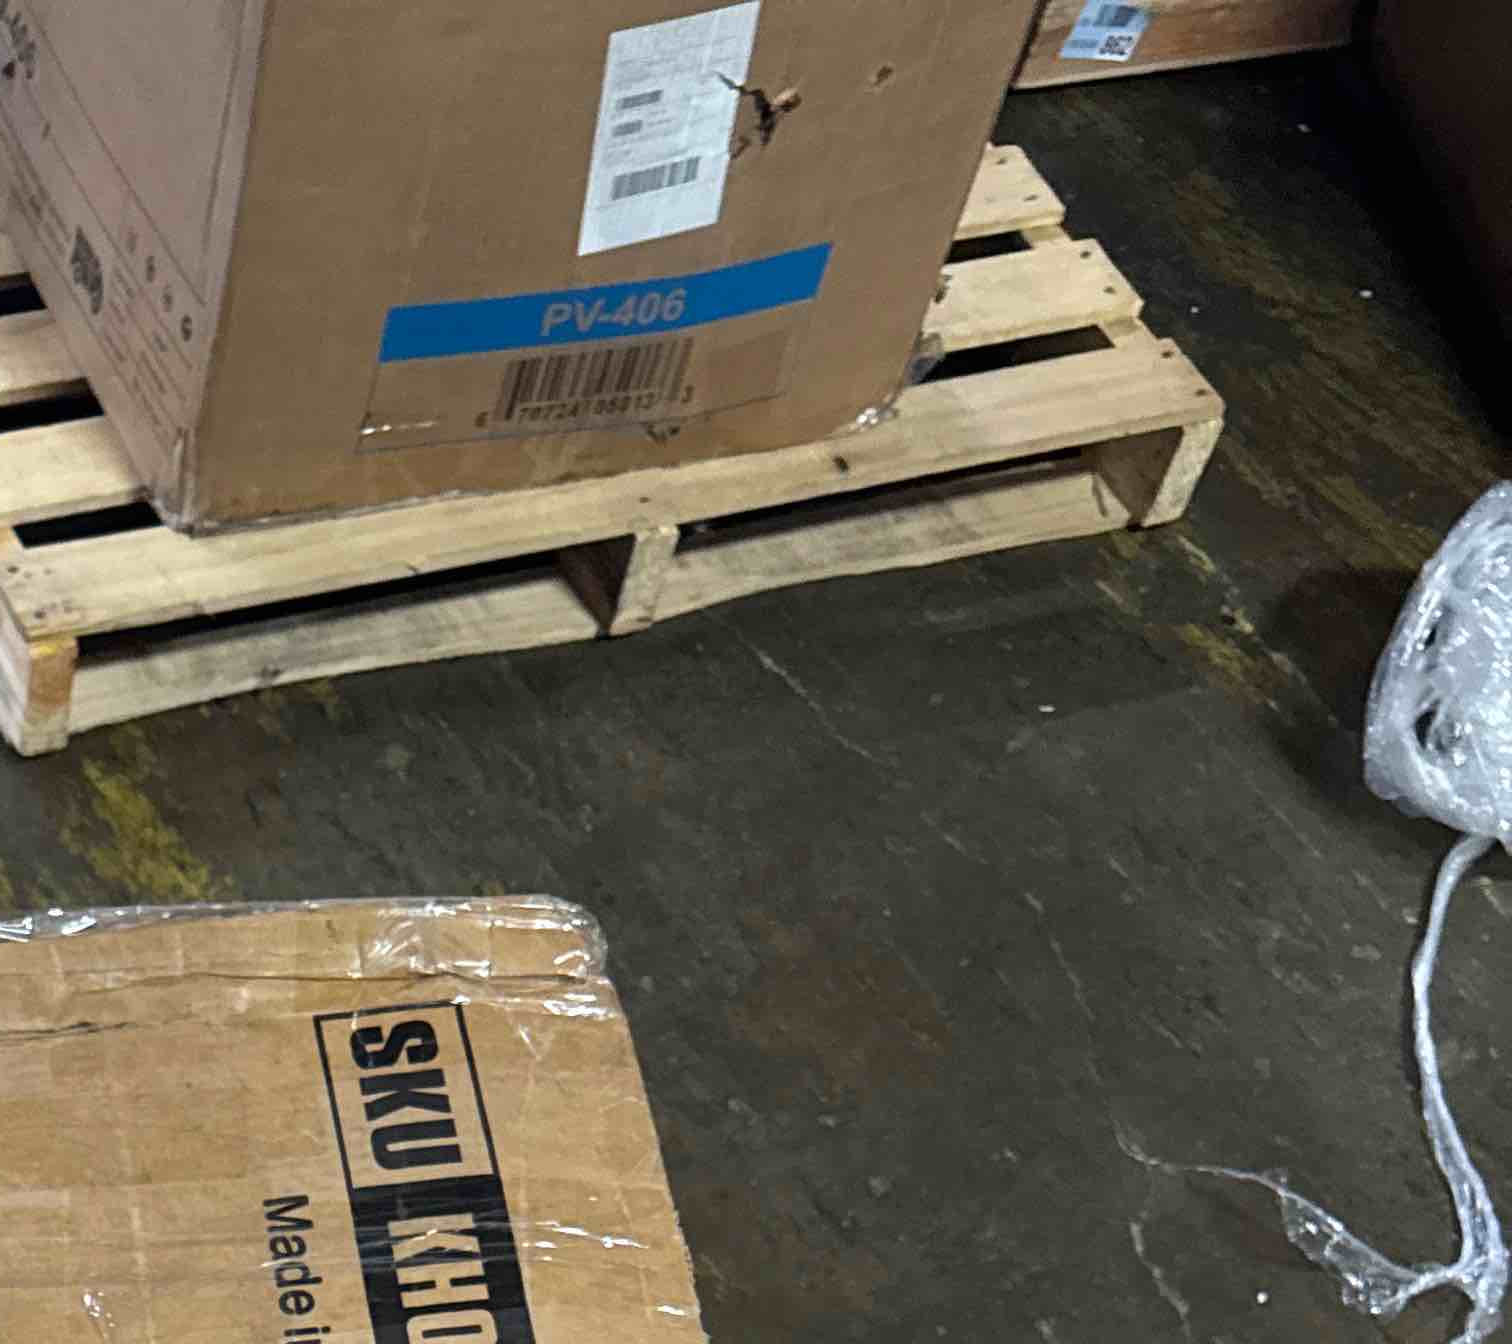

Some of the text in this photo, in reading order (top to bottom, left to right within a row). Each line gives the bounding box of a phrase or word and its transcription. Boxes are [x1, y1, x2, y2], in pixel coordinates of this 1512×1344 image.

[541, 288, 686, 336] PV-406
[350, 1020, 462, 1170] SKU
[263, 1195, 323, 1316] Made
